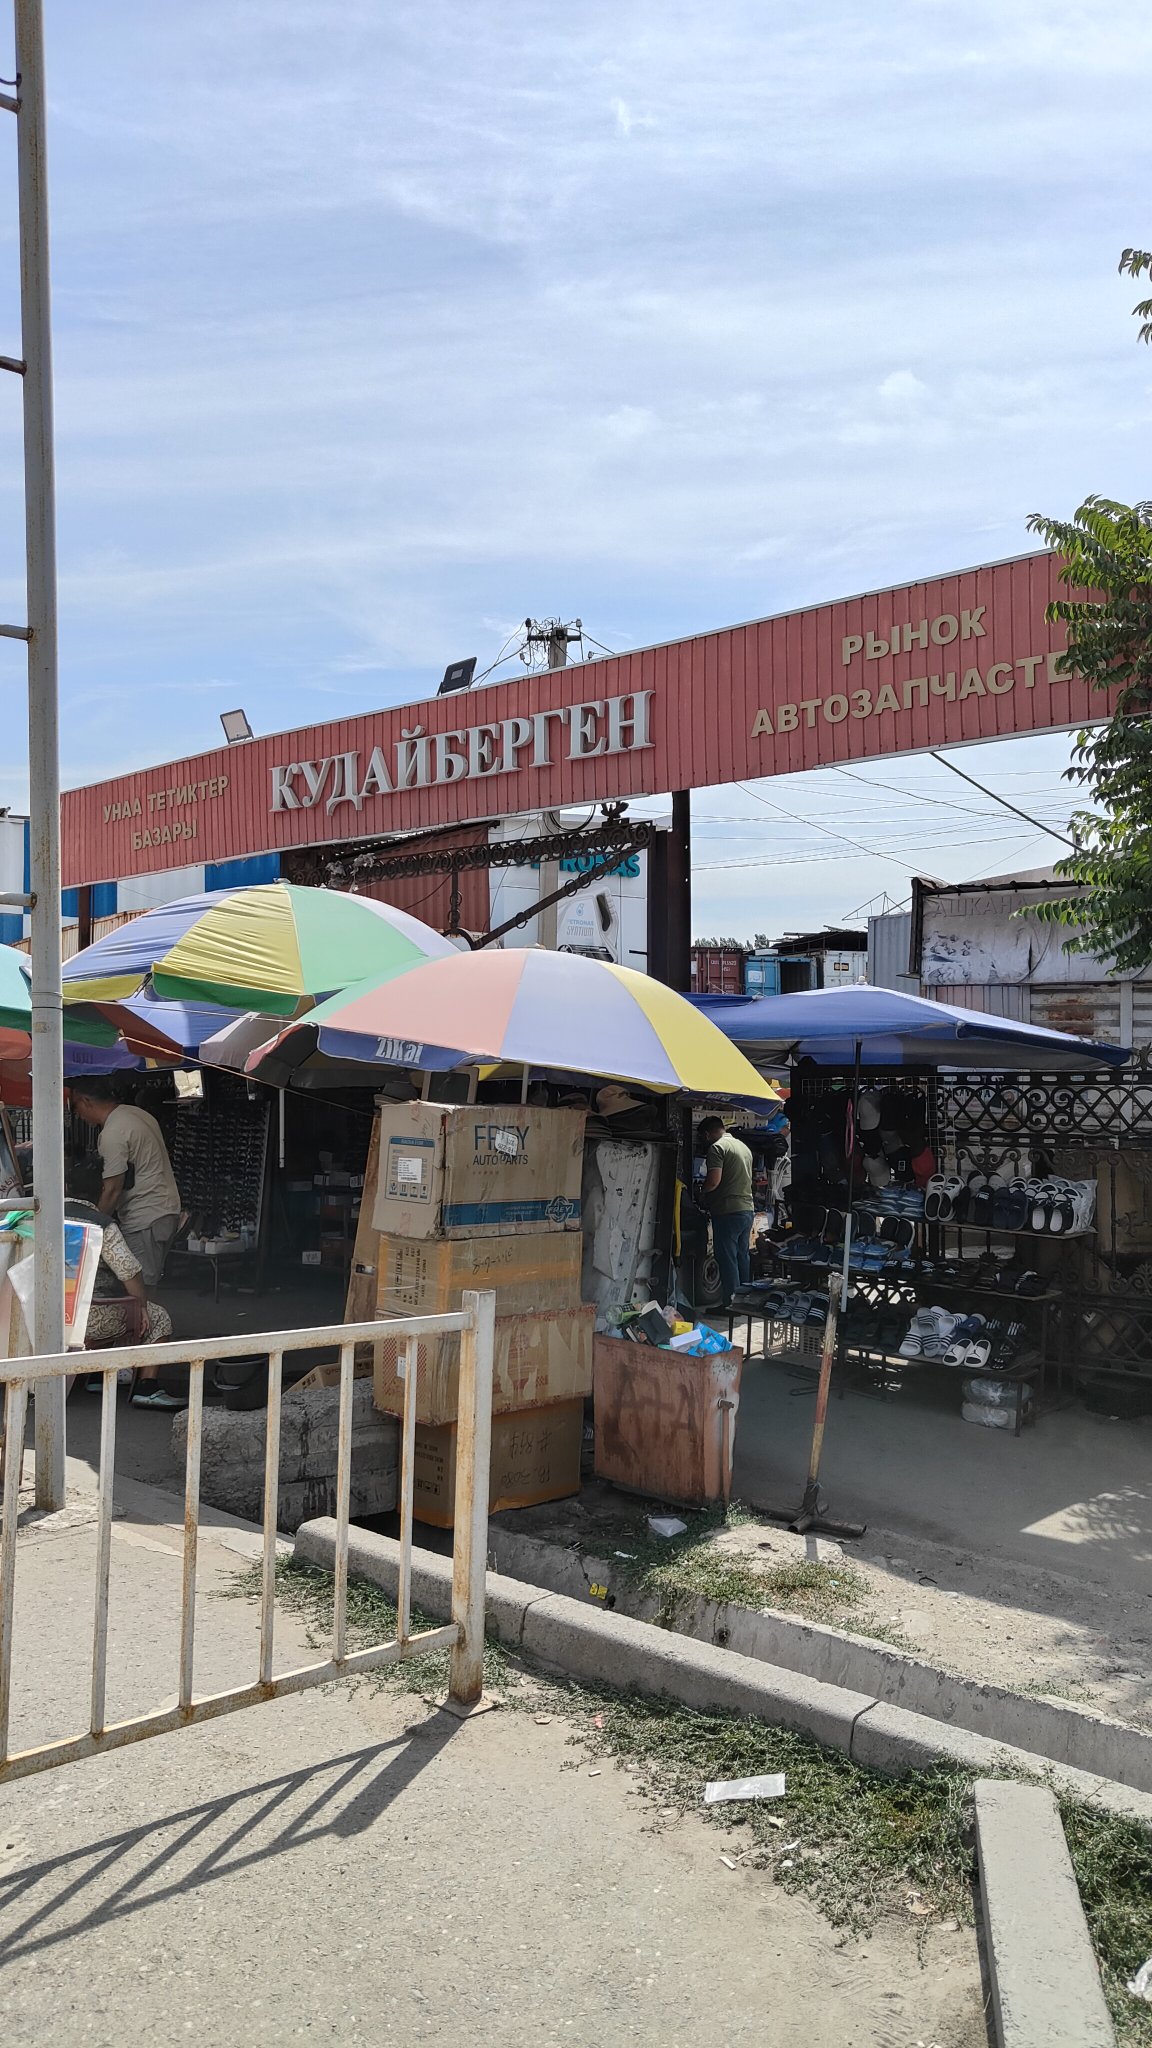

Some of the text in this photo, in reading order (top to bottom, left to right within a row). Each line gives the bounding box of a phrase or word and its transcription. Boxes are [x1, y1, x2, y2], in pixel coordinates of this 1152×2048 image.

[842, 606, 986, 666] РЫНОК
[751, 650, 1106, 738] АВТОЗАПЧАСТЕ
[269, 689, 656, 817] КУДАЙБЕРГЕН
[103, 775, 229, 824] УНАА ТЕТИКТЕР
[131, 819, 198, 851] БАЗАРЫ
[474, 1125, 530, 1150] FRY
[473, 1154, 529, 1166] AUTO PARTS
[547, 1205, 574, 1214] FREY
